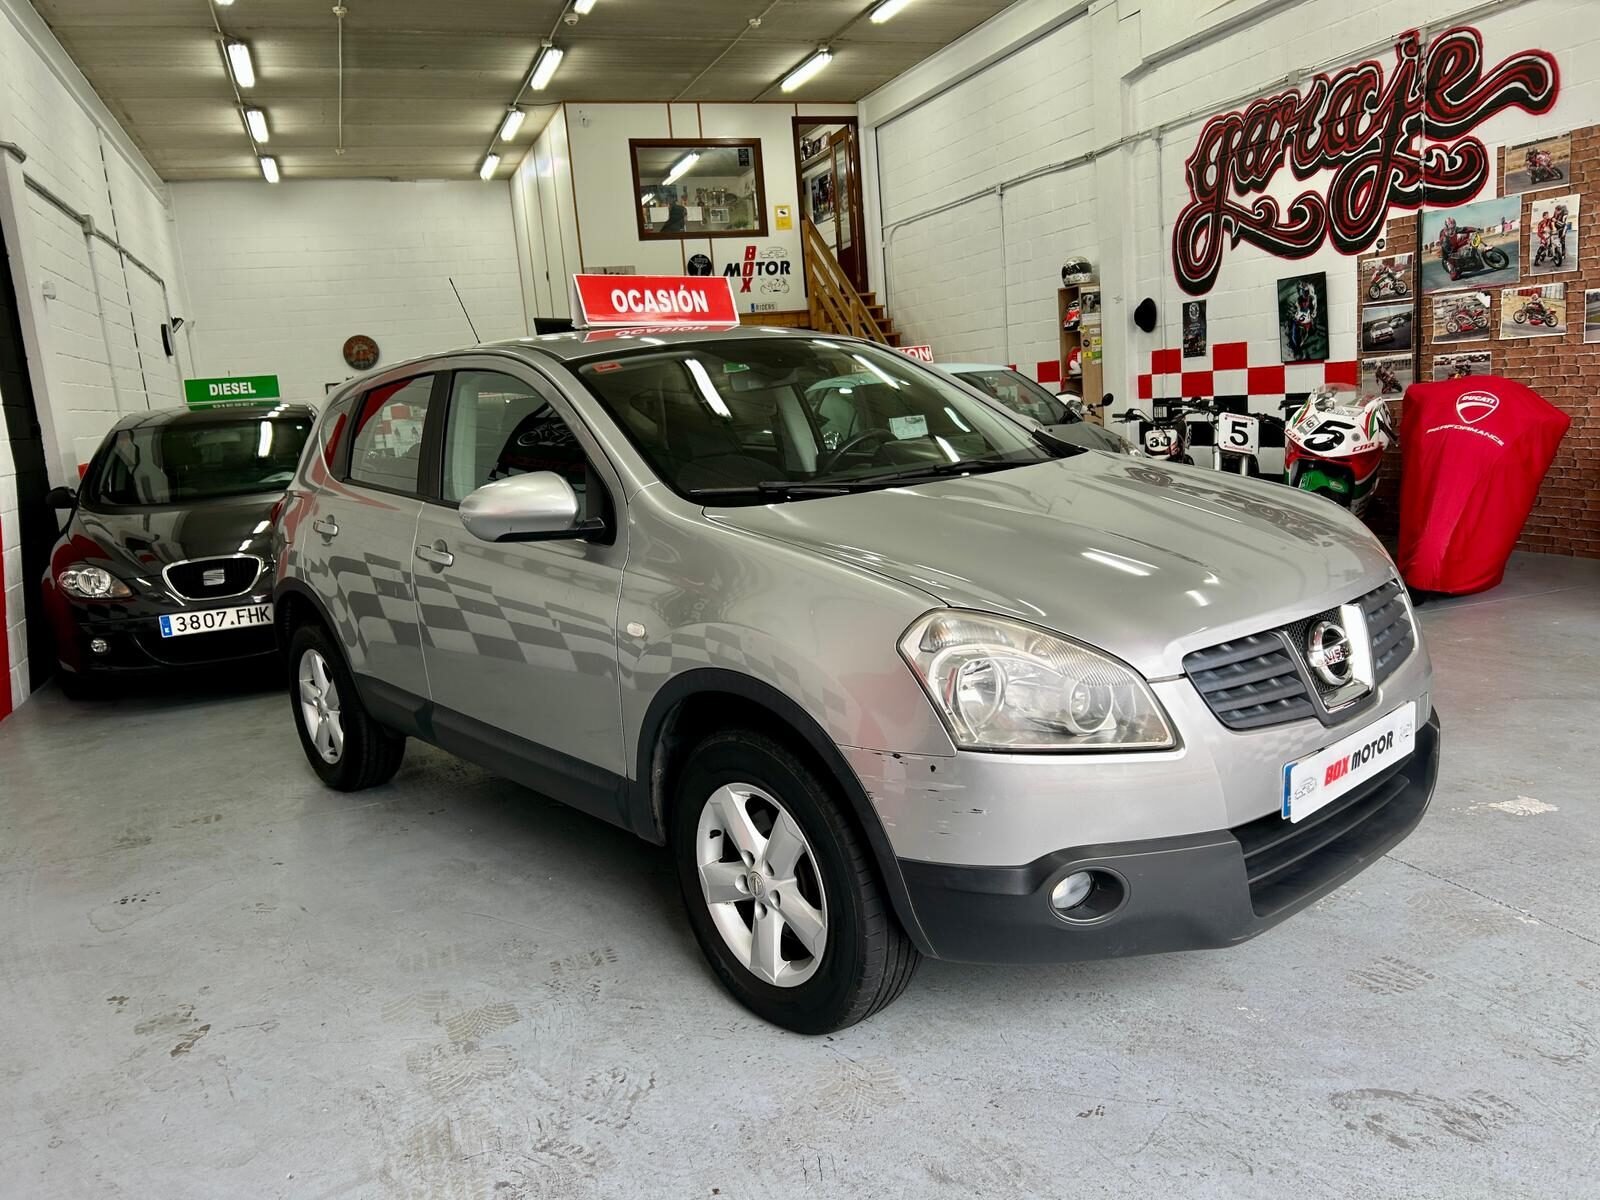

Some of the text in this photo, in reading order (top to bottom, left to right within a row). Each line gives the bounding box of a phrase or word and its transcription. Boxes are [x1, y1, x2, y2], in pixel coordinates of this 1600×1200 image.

[1173, 26, 1560, 296] garaje
[723, 260, 791, 277] MOTOR
[740, 246, 757, 293] BOX
[611, 285, 709, 313] OCASIÓN
[209, 382, 256, 396] DIESEL
[1462, 395, 1495, 404] DUCATI
[1230, 420, 1249, 446] 5
[1303, 420, 1356, 452] 5
[175, 605, 271, 632] 3807 FHK
[1324, 730, 1394, 787] BOX MOTOR
